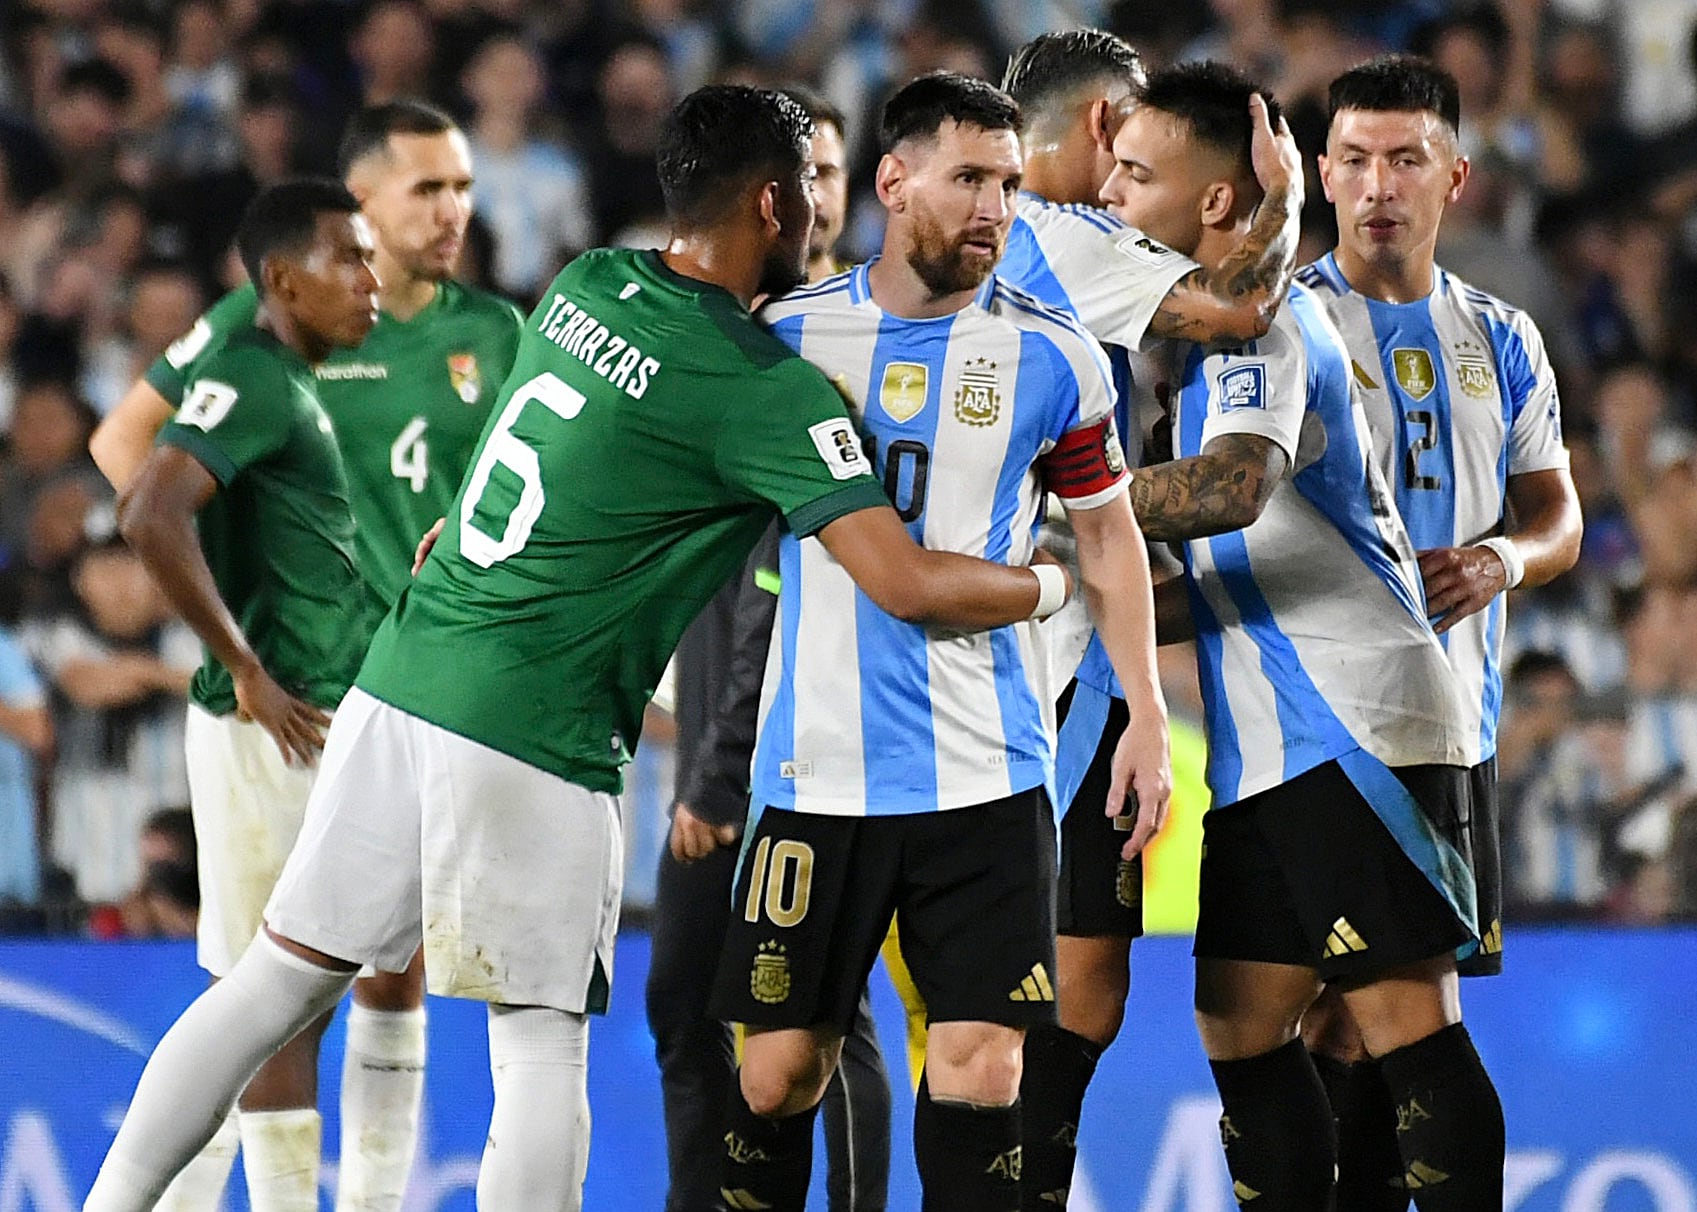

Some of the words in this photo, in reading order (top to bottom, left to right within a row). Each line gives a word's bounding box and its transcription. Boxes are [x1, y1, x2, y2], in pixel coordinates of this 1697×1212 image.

[538, 293, 661, 400] TERRAZAS
[1466, 367, 1489, 388] AFA
[963, 386, 992, 413] AFA
[391, 416, 428, 493] 4
[459, 371, 588, 570] 6
[1405, 410, 1441, 490] 2
[745, 836, 814, 927] 10
